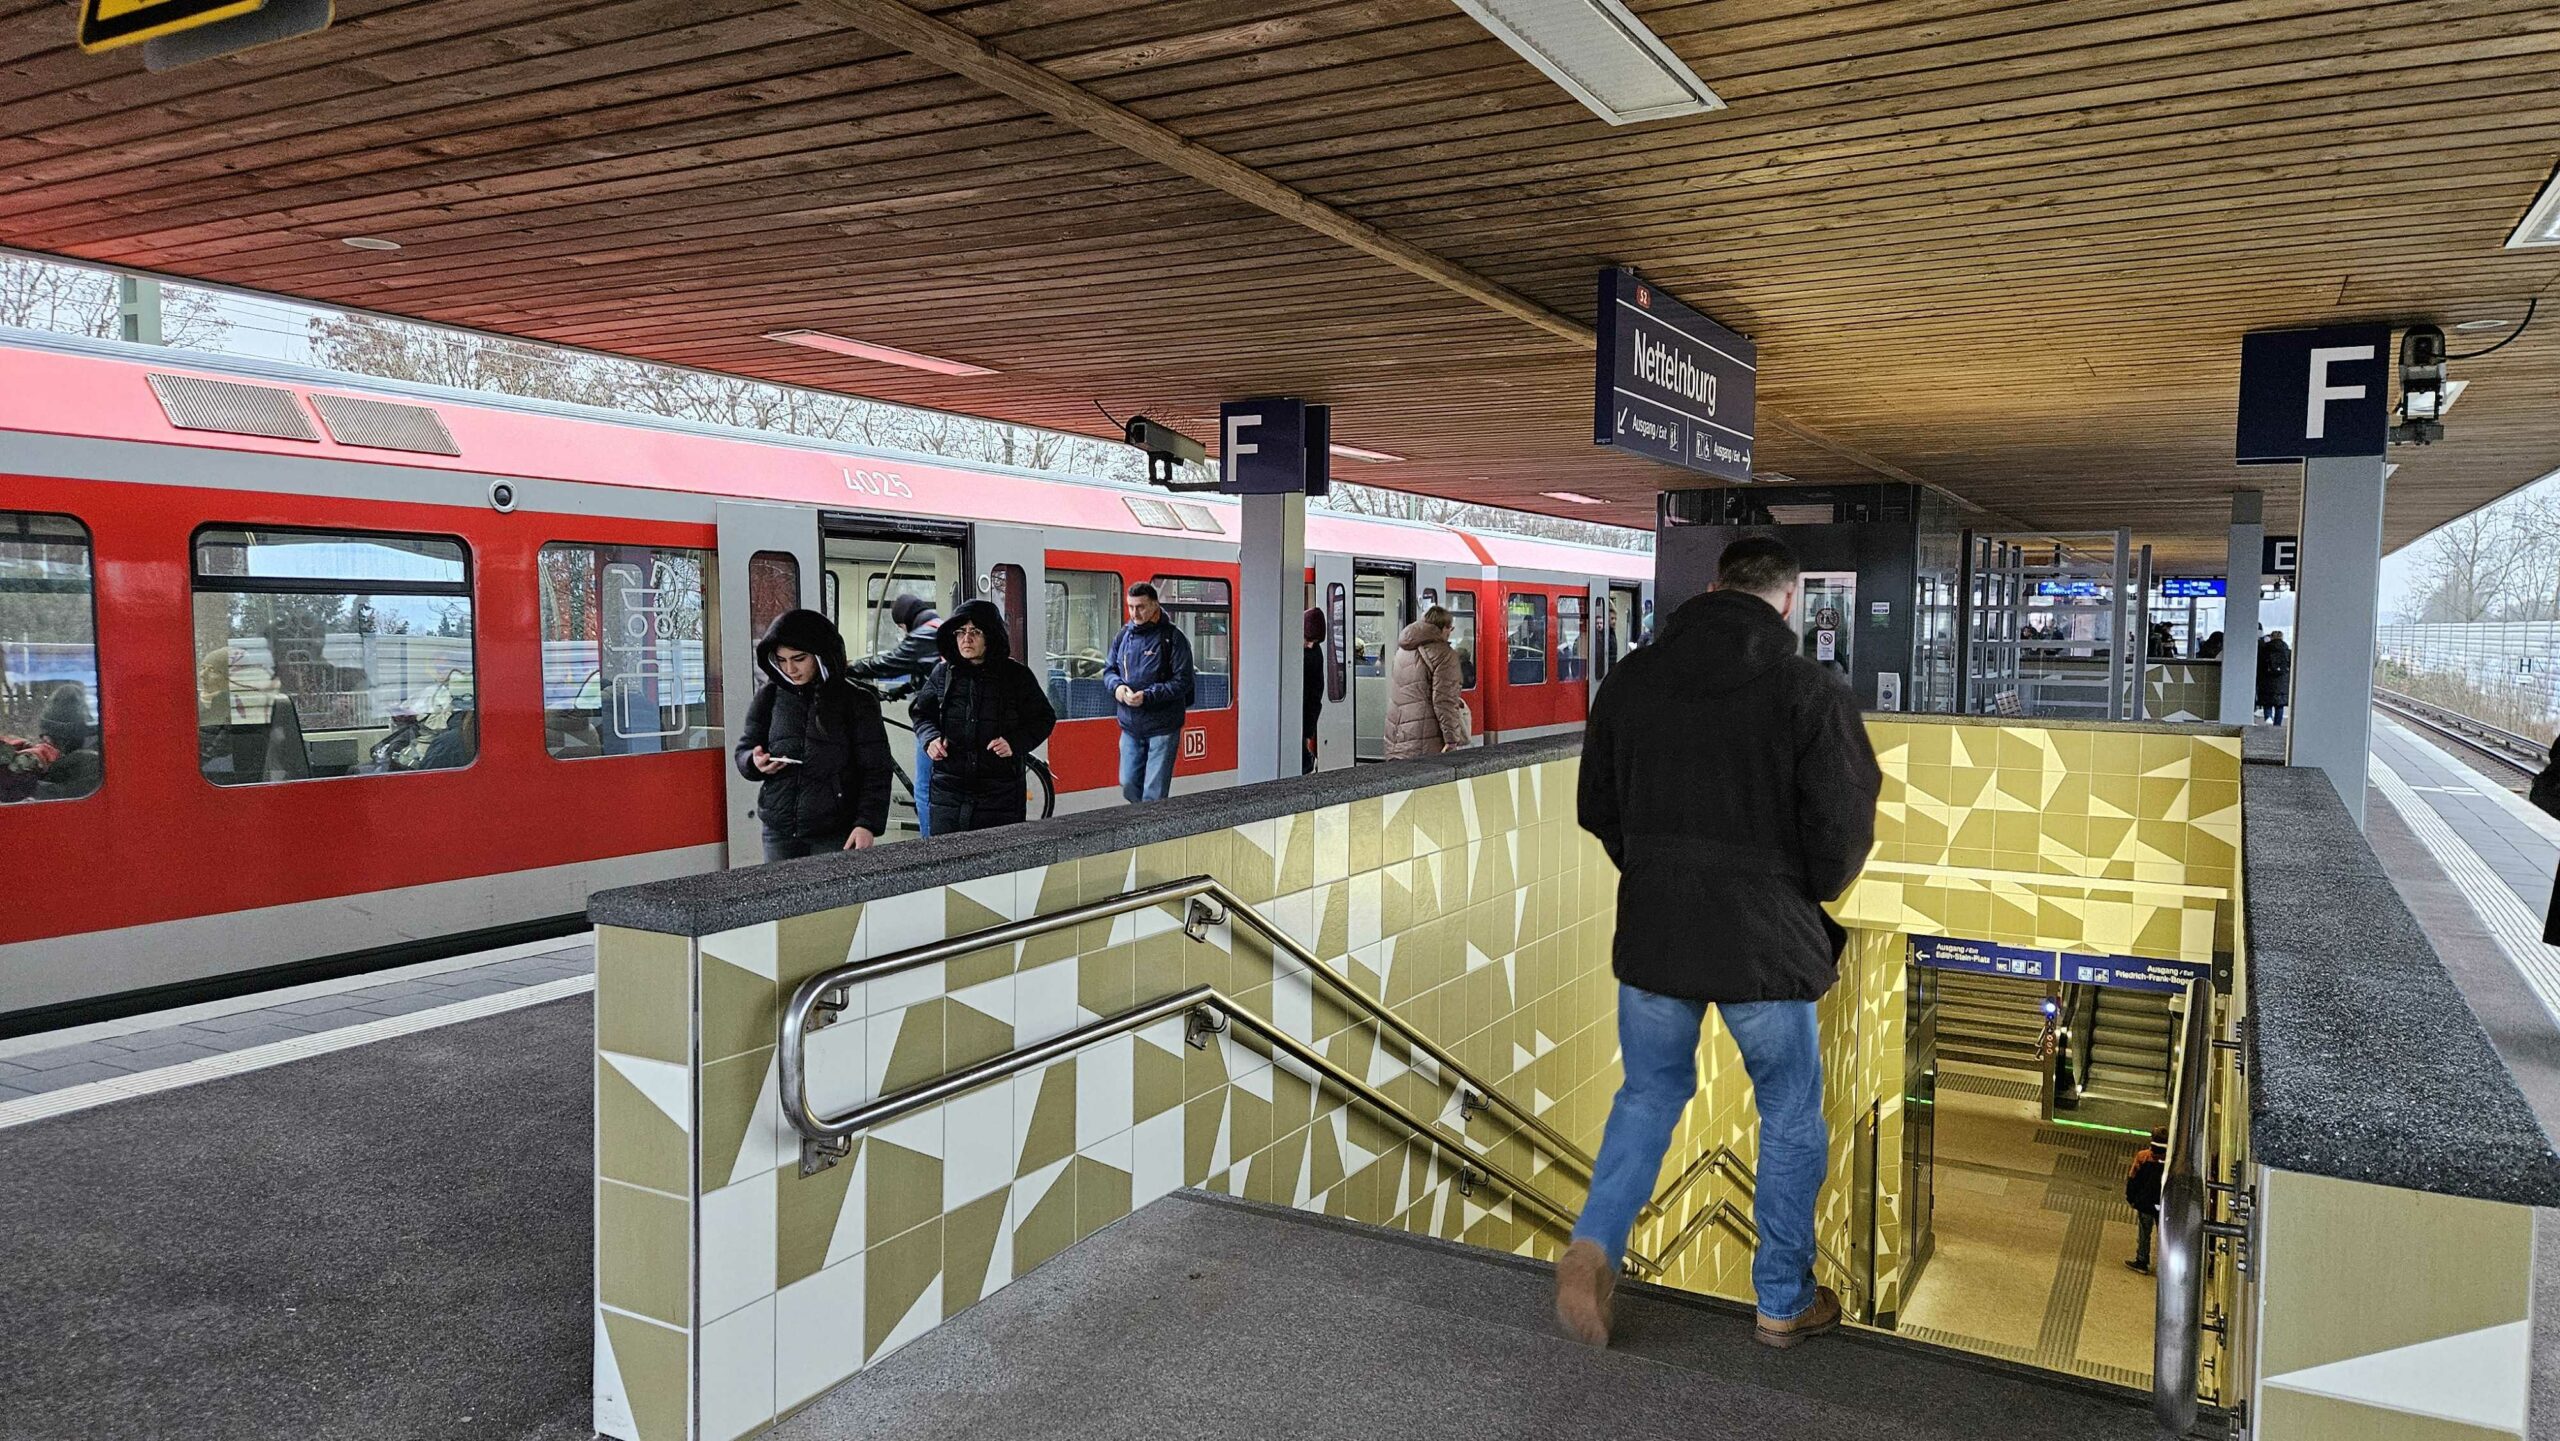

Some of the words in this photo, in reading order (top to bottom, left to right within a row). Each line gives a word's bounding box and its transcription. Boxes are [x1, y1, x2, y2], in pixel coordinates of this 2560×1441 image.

[1640, 289, 1648, 304] S2
[1634, 329, 1717, 417] Nettelnburg
[2305, 345, 2376, 439] F
[1633, 414, 1656, 440] Ausgang
[1227, 414, 1263, 482] F
[1714, 443, 1731, 463] Ausgang
[842, 468, 913, 499] 4025
[2275, 542, 2296, 570] E
[2519, 658, 2532, 673] H
[1185, 732, 1205, 755] DB
[1936, 943, 1965, 954] Ausgang
[1936, 951, 1990, 963] Edith-Stein-Platz
[2147, 965, 2178, 976] Ausgang
